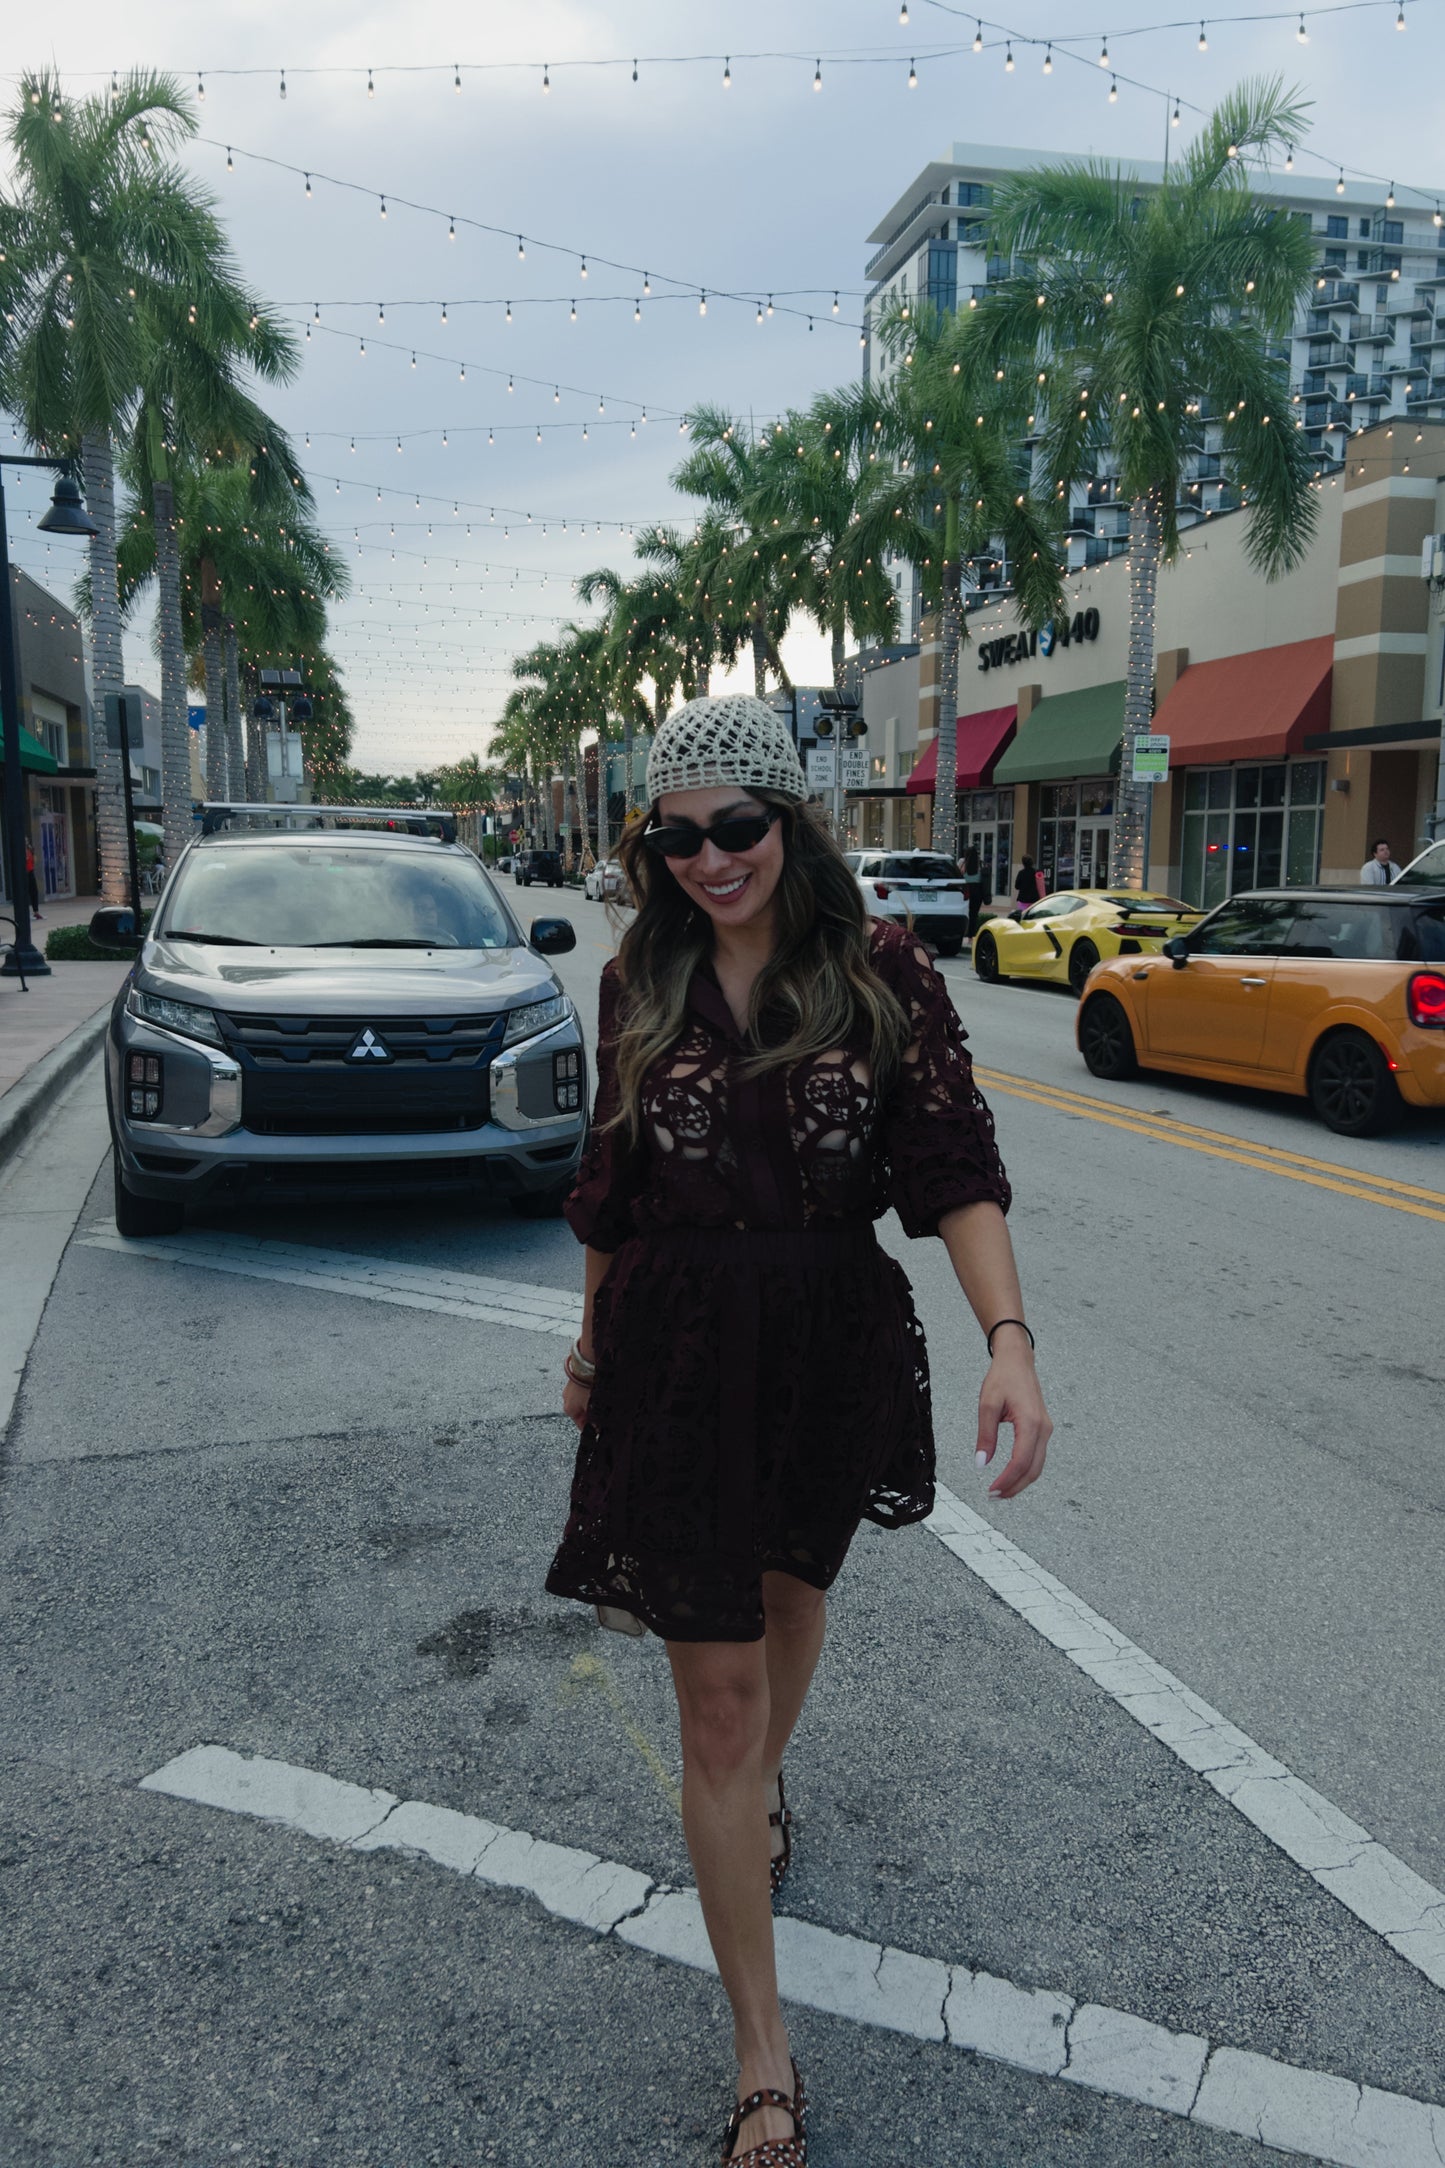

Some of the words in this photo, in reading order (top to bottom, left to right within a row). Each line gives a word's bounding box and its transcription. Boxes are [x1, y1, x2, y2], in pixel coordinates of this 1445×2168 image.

[978, 629, 1038, 671] SWEAT
[849, 751, 863, 759] END
[843, 760, 869, 768] DOUBLE
[815, 774, 828, 782] ZONE
[846, 770, 866, 778] FINES
[846, 779, 864, 787] ZONE
